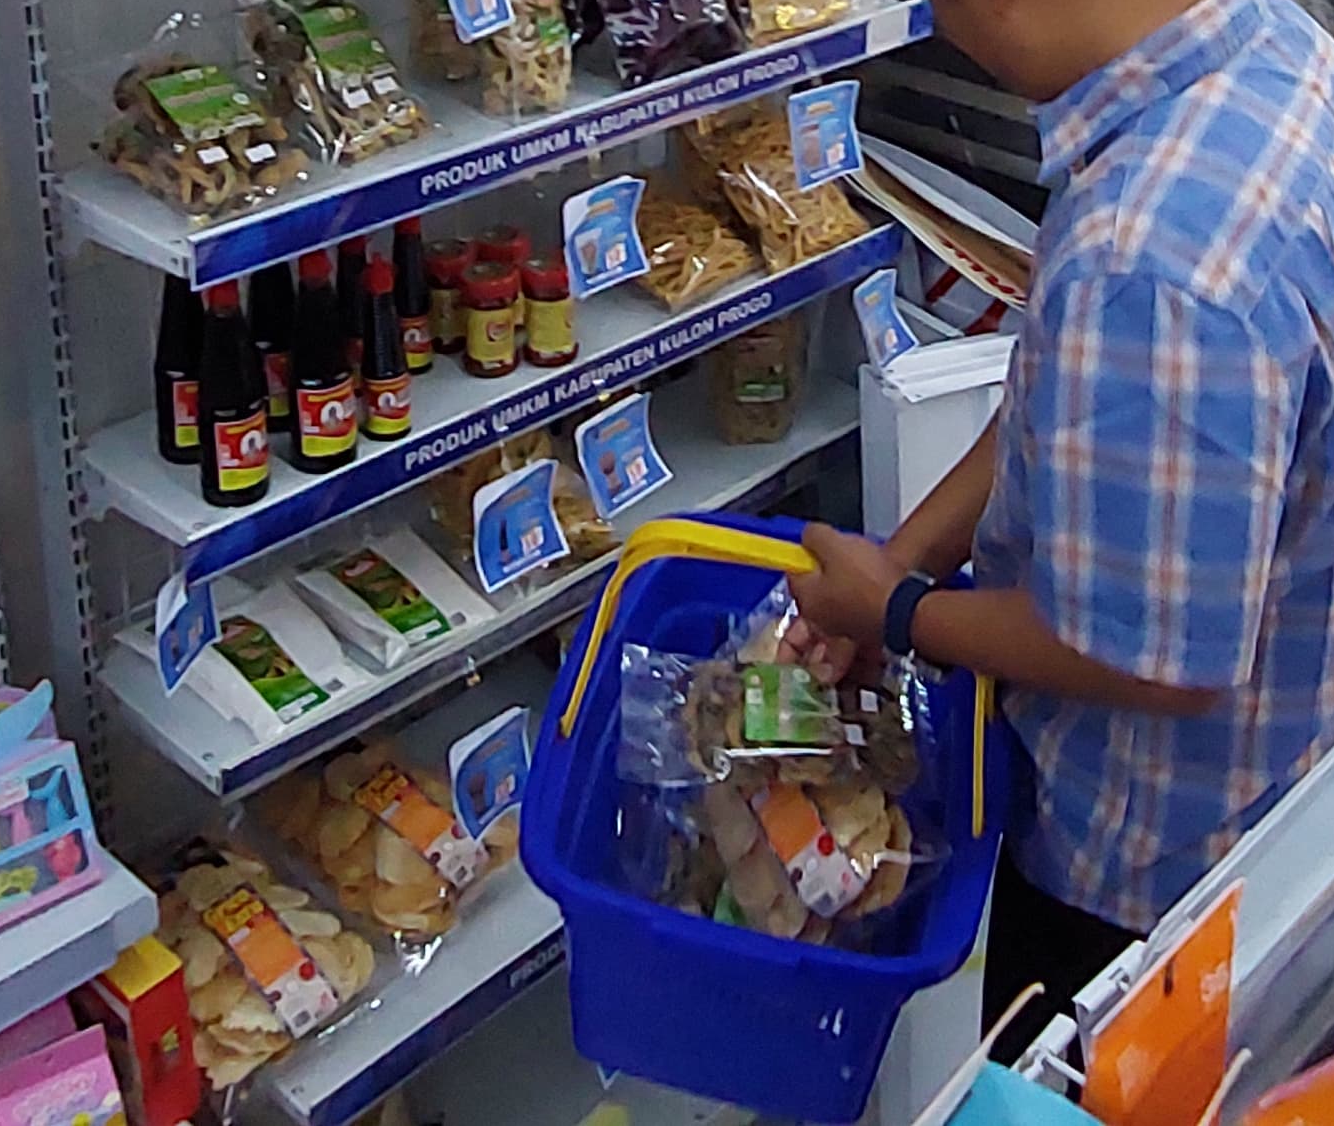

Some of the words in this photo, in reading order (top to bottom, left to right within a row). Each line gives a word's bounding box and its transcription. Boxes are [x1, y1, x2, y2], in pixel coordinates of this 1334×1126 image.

[420, 151, 506, 196] PRODUK
[511, 129, 571, 165] UMKM
[575, 94, 680, 143] KABUPATEN
[683, 77, 740, 107] KULON
[743, 53, 799, 88] PROGO
[404, 423, 487, 470] PRODUK
[492, 392, 551, 433] UMKM
[553, 344, 656, 404] KABUPATEN
[659, 317, 715, 355] KULON
[718, 292, 772, 329] PROGO
